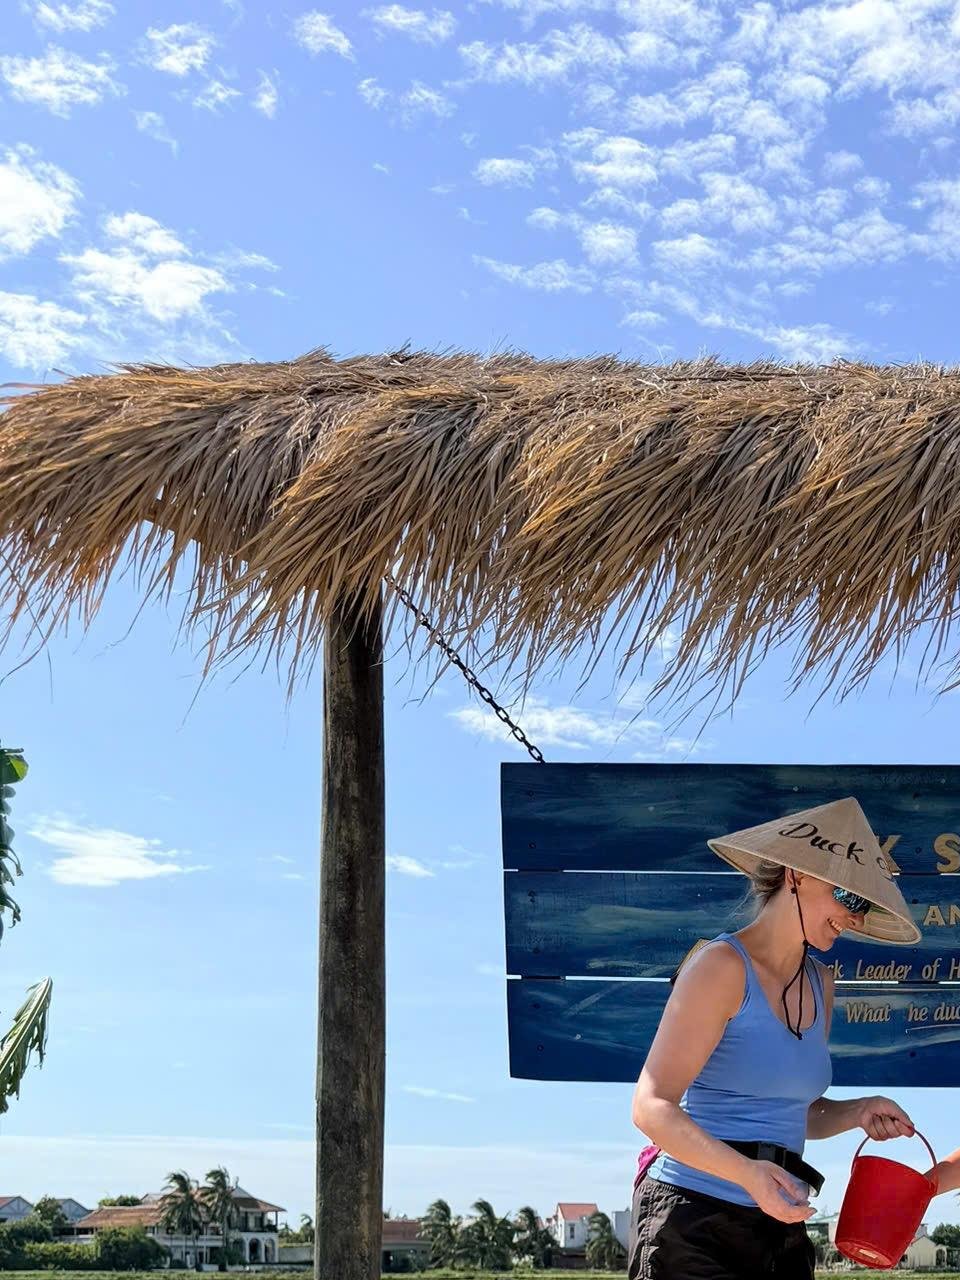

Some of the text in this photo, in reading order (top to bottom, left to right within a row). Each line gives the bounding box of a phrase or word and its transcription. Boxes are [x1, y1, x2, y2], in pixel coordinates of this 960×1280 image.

[777, 822, 866, 867] Duck
[855, 958, 913, 981] Leader
[921, 957, 943, 981] of
[846, 1001, 892, 1025] What
